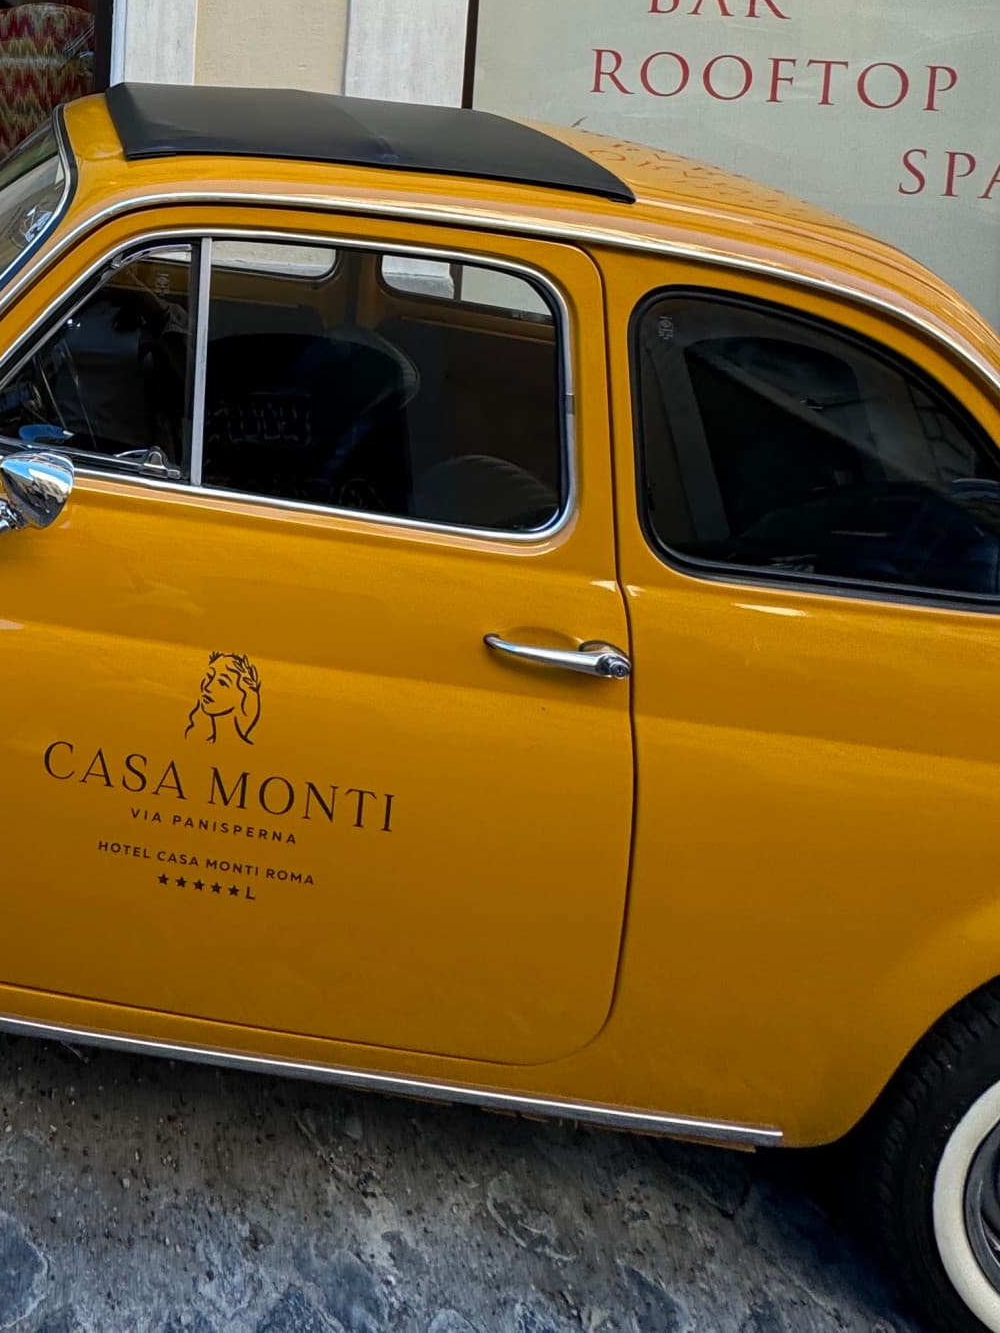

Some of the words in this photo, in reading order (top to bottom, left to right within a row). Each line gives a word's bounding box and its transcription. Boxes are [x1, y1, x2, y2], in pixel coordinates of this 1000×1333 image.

[590, 48, 958, 112] ROOFTOP
[43, 740, 188, 801] CASA
[207, 766, 395, 833] MONTI
[130, 807, 162, 824] VIA
[172, 814, 297, 845] PANISPERNA
[97, 840, 151, 859] HOTEL
[156, 850, 200, 868] CASA
[205, 857, 259, 877] MONTI
[265, 867, 315, 886] ROMA
